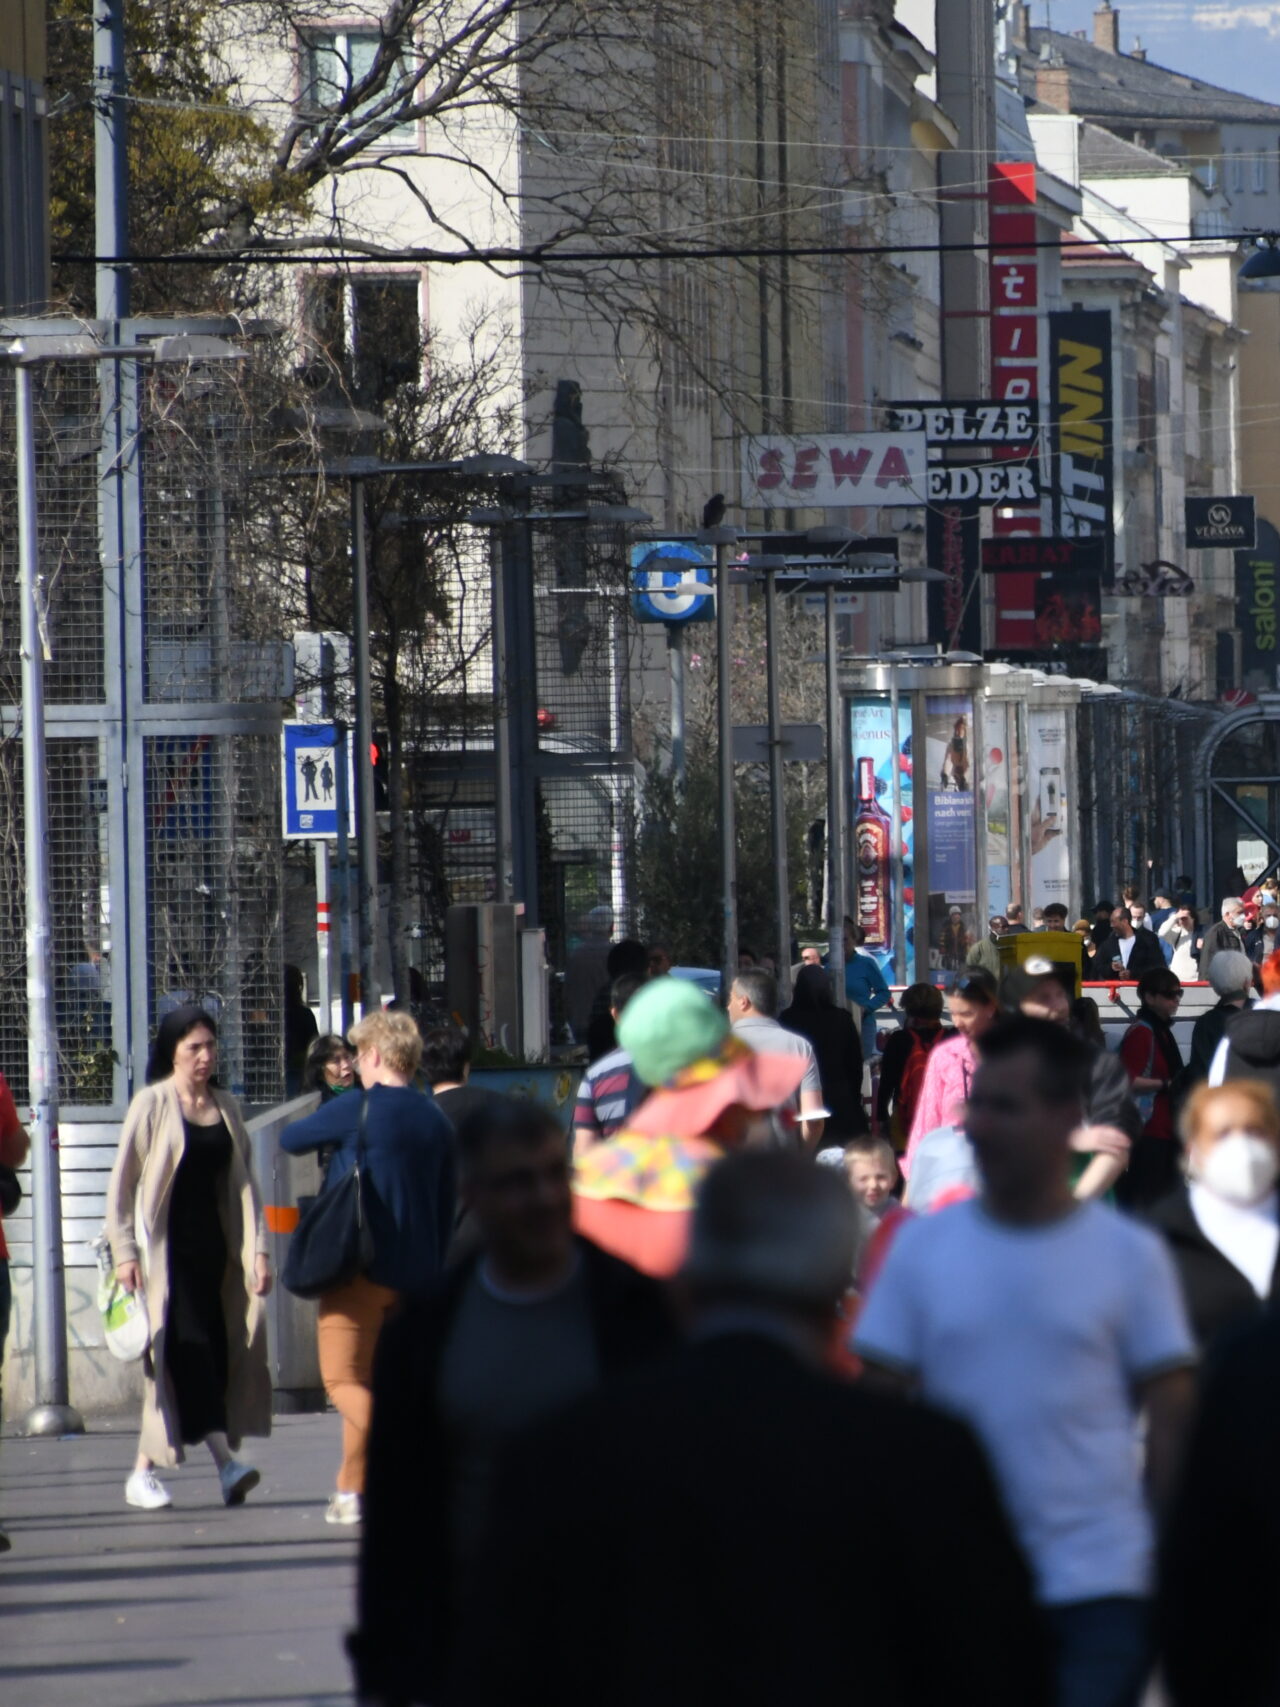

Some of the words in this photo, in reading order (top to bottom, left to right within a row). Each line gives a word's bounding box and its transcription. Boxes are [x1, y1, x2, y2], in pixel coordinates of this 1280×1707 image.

[757, 447, 912, 489] SEWA
[647, 568, 697, 614] U
[1249, 561, 1277, 650] saloni
